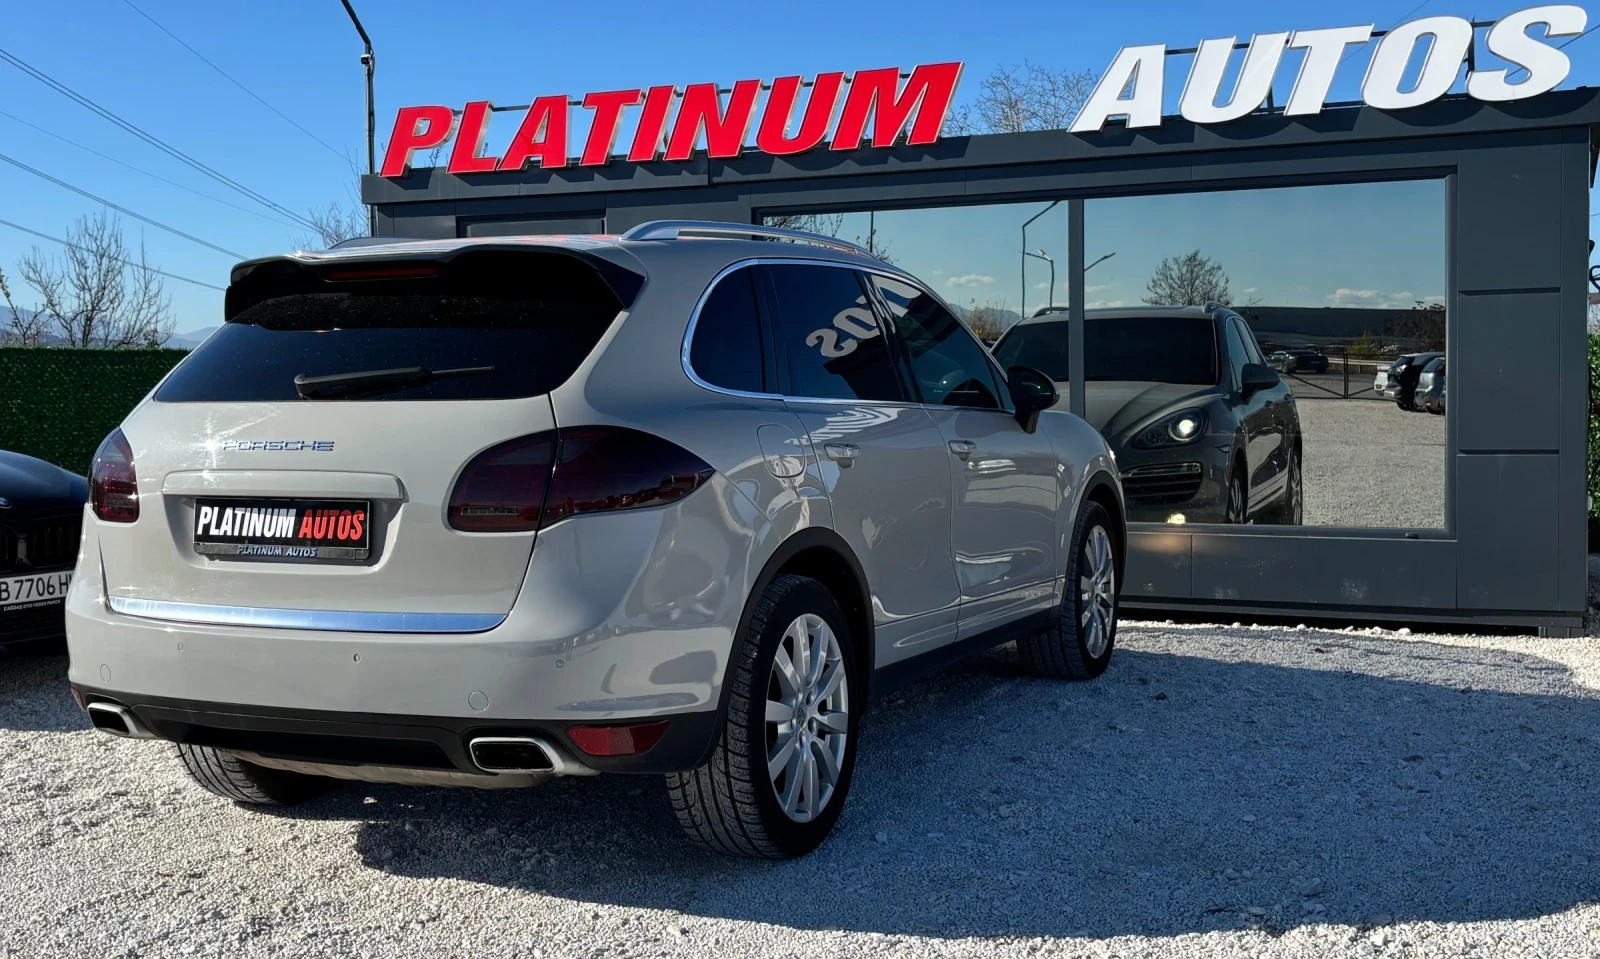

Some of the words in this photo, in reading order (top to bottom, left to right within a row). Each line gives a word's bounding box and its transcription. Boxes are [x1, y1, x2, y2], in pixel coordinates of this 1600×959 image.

[379, 61, 965, 178] PLATINUM
[1067, 4, 1588, 133] AUTOS
[222, 440, 335, 452] PORSCHE
[197, 506, 297, 538] PLATINUM
[298, 509, 365, 541] AUTOS
[237, 545, 282, 556] PLATINUM
[286, 547, 318, 557] AUTOS
[58, 573, 72, 595] H
